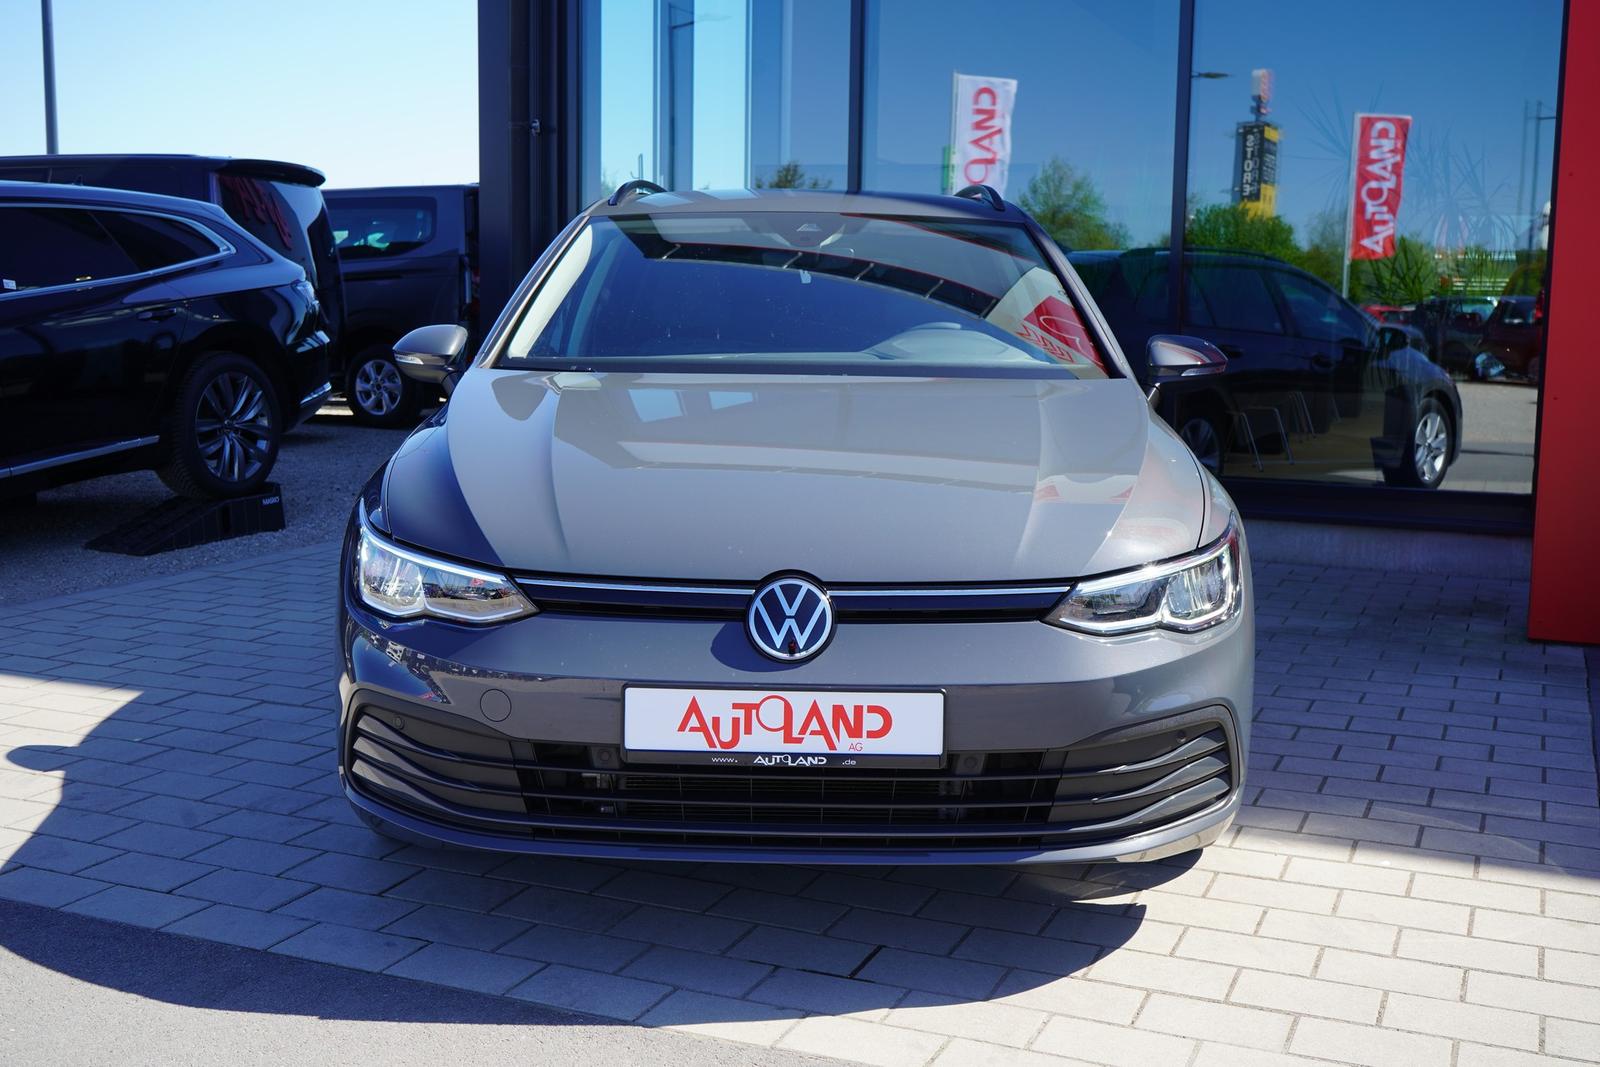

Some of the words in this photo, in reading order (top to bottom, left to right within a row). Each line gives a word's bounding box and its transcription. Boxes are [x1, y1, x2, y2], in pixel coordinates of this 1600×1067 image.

[677, 694, 893, 751] AUTOLAND
[848, 742, 864, 752] AG
[753, 754, 827, 767] AUTOLAND
